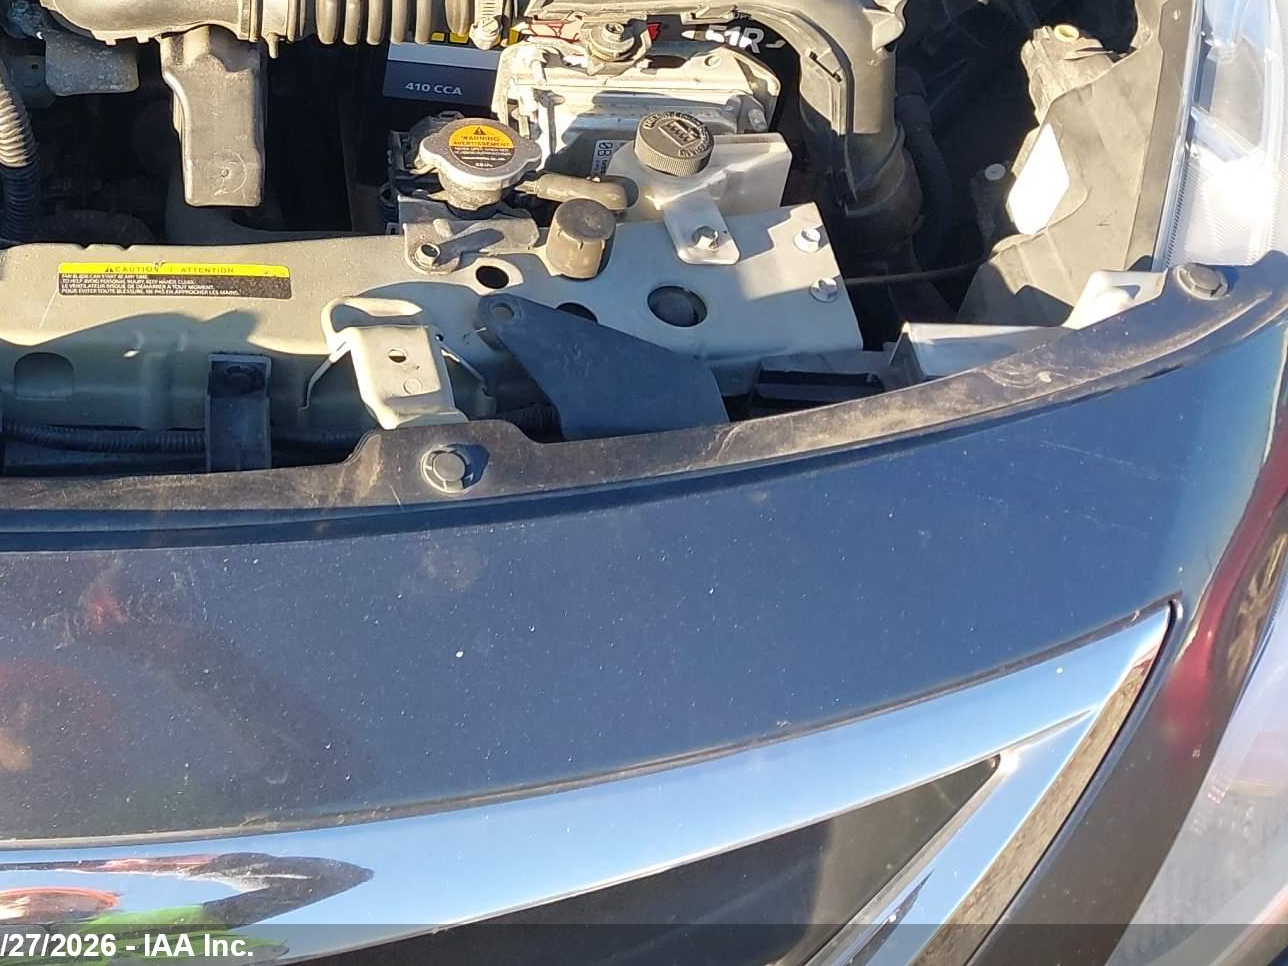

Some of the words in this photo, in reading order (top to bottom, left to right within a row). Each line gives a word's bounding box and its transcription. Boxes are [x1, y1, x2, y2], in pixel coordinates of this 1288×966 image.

[705, 24, 765, 54] 51R
[405, 82, 431, 92] 410
[433, 84, 462, 95] CCA
